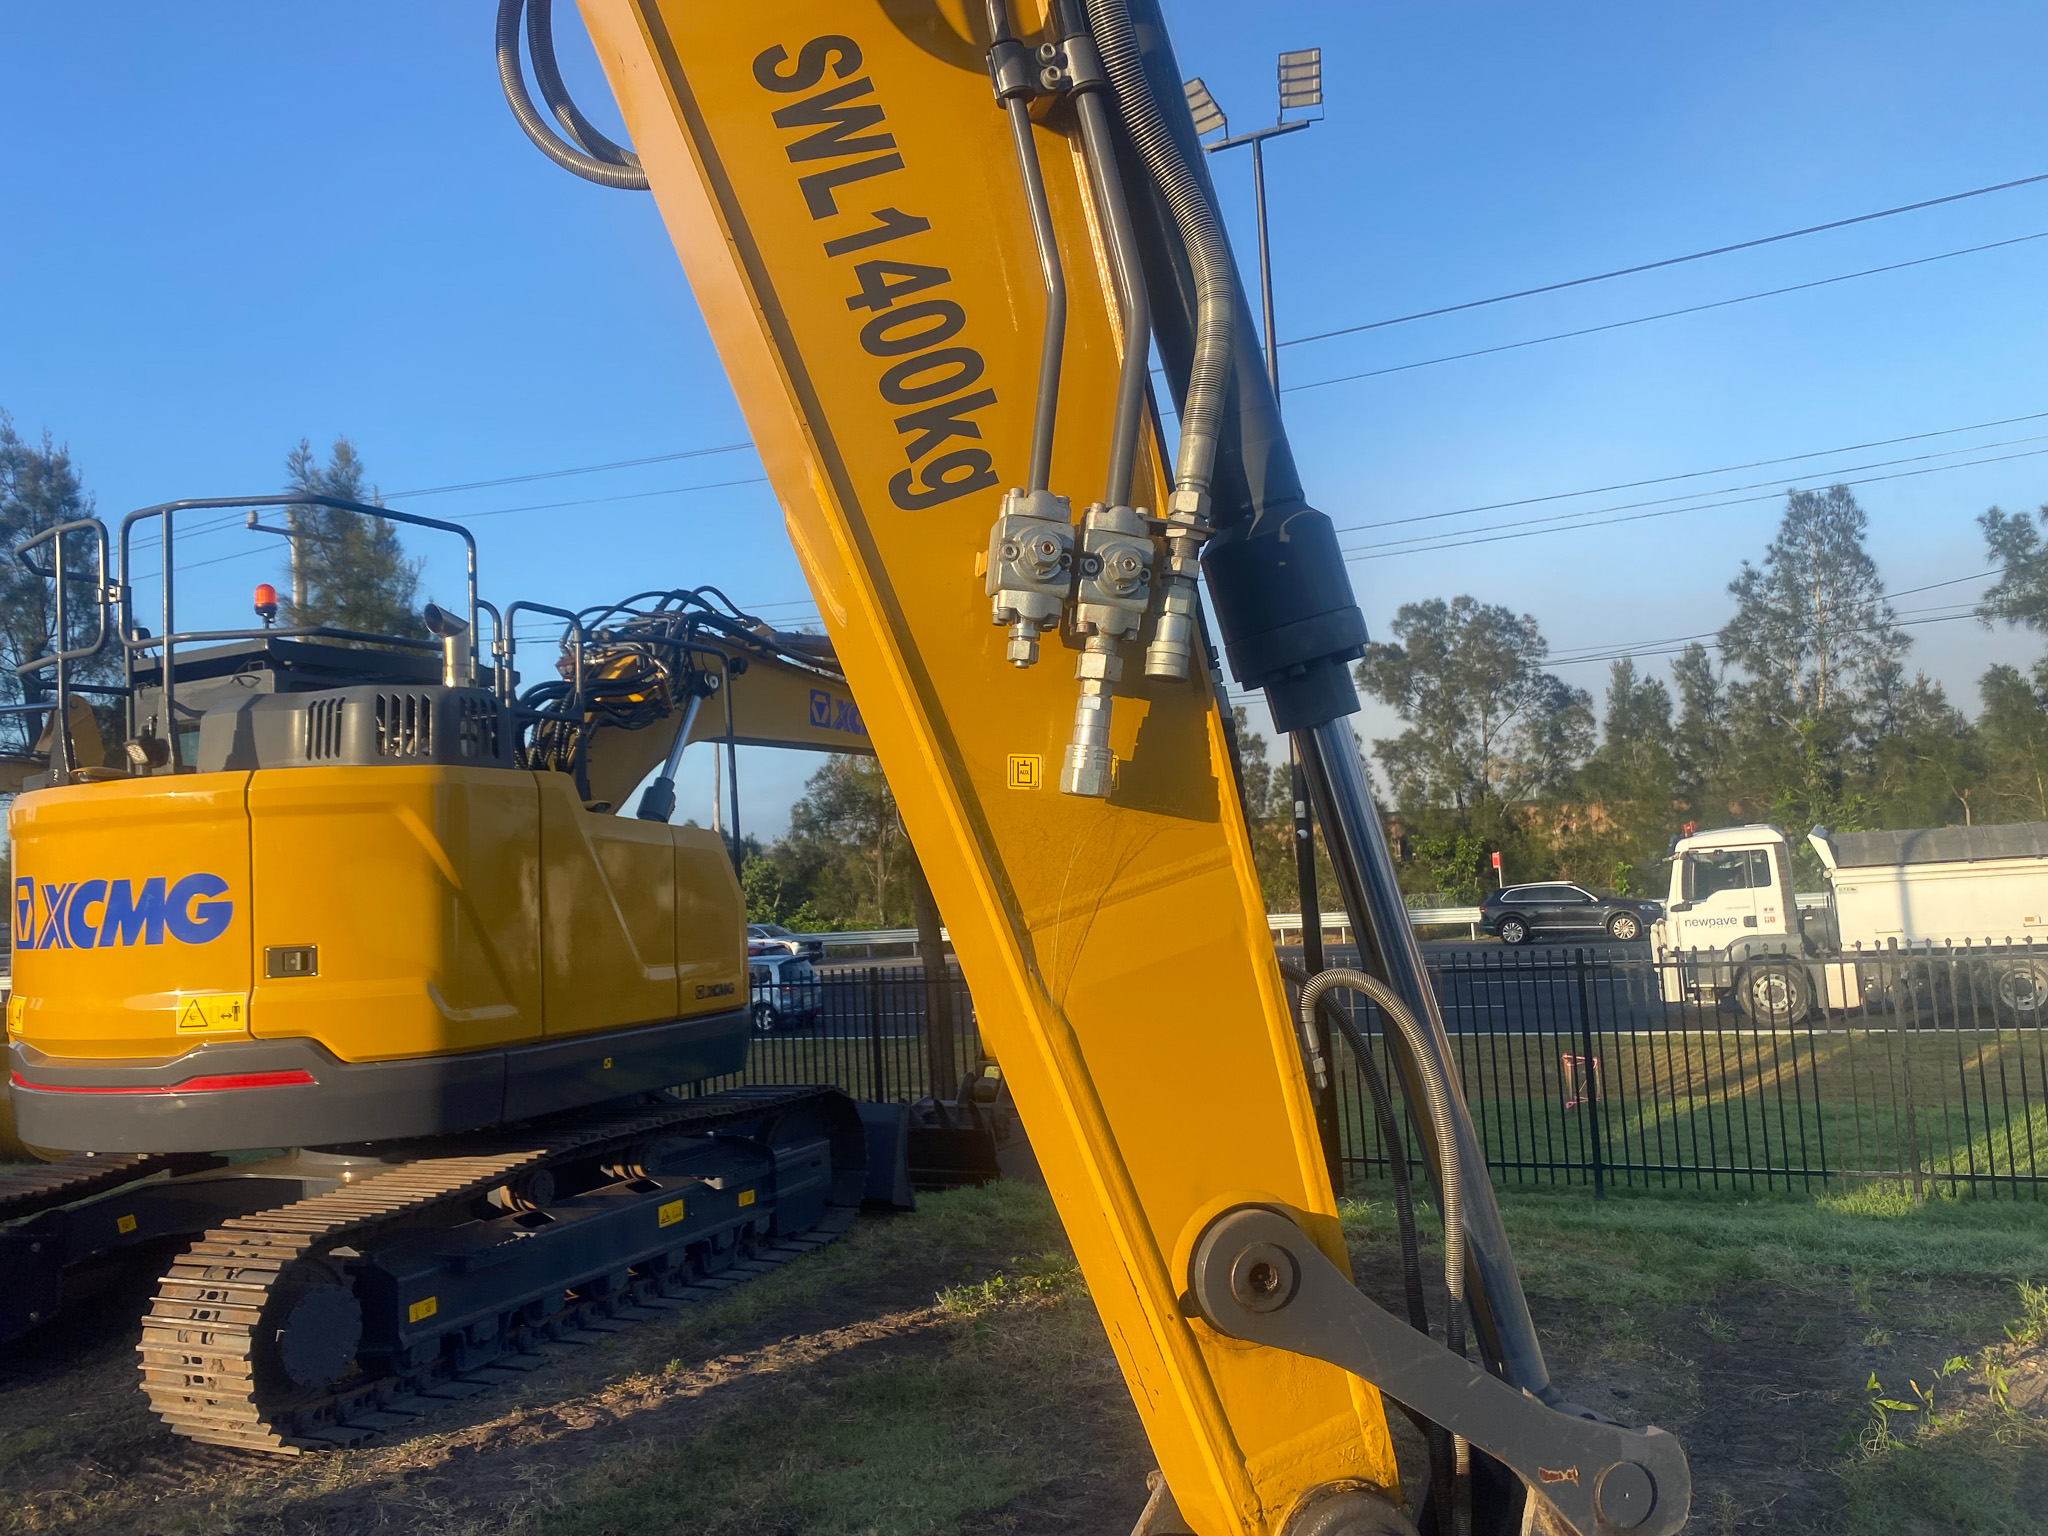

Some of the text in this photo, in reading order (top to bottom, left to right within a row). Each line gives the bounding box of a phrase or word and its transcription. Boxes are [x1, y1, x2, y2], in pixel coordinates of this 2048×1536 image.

[752, 34, 1000, 512] SWL 1400kg
[831, 698, 868, 737] XC
[36, 873, 234, 950] XCMG
[1684, 916, 1738, 928] newpave
